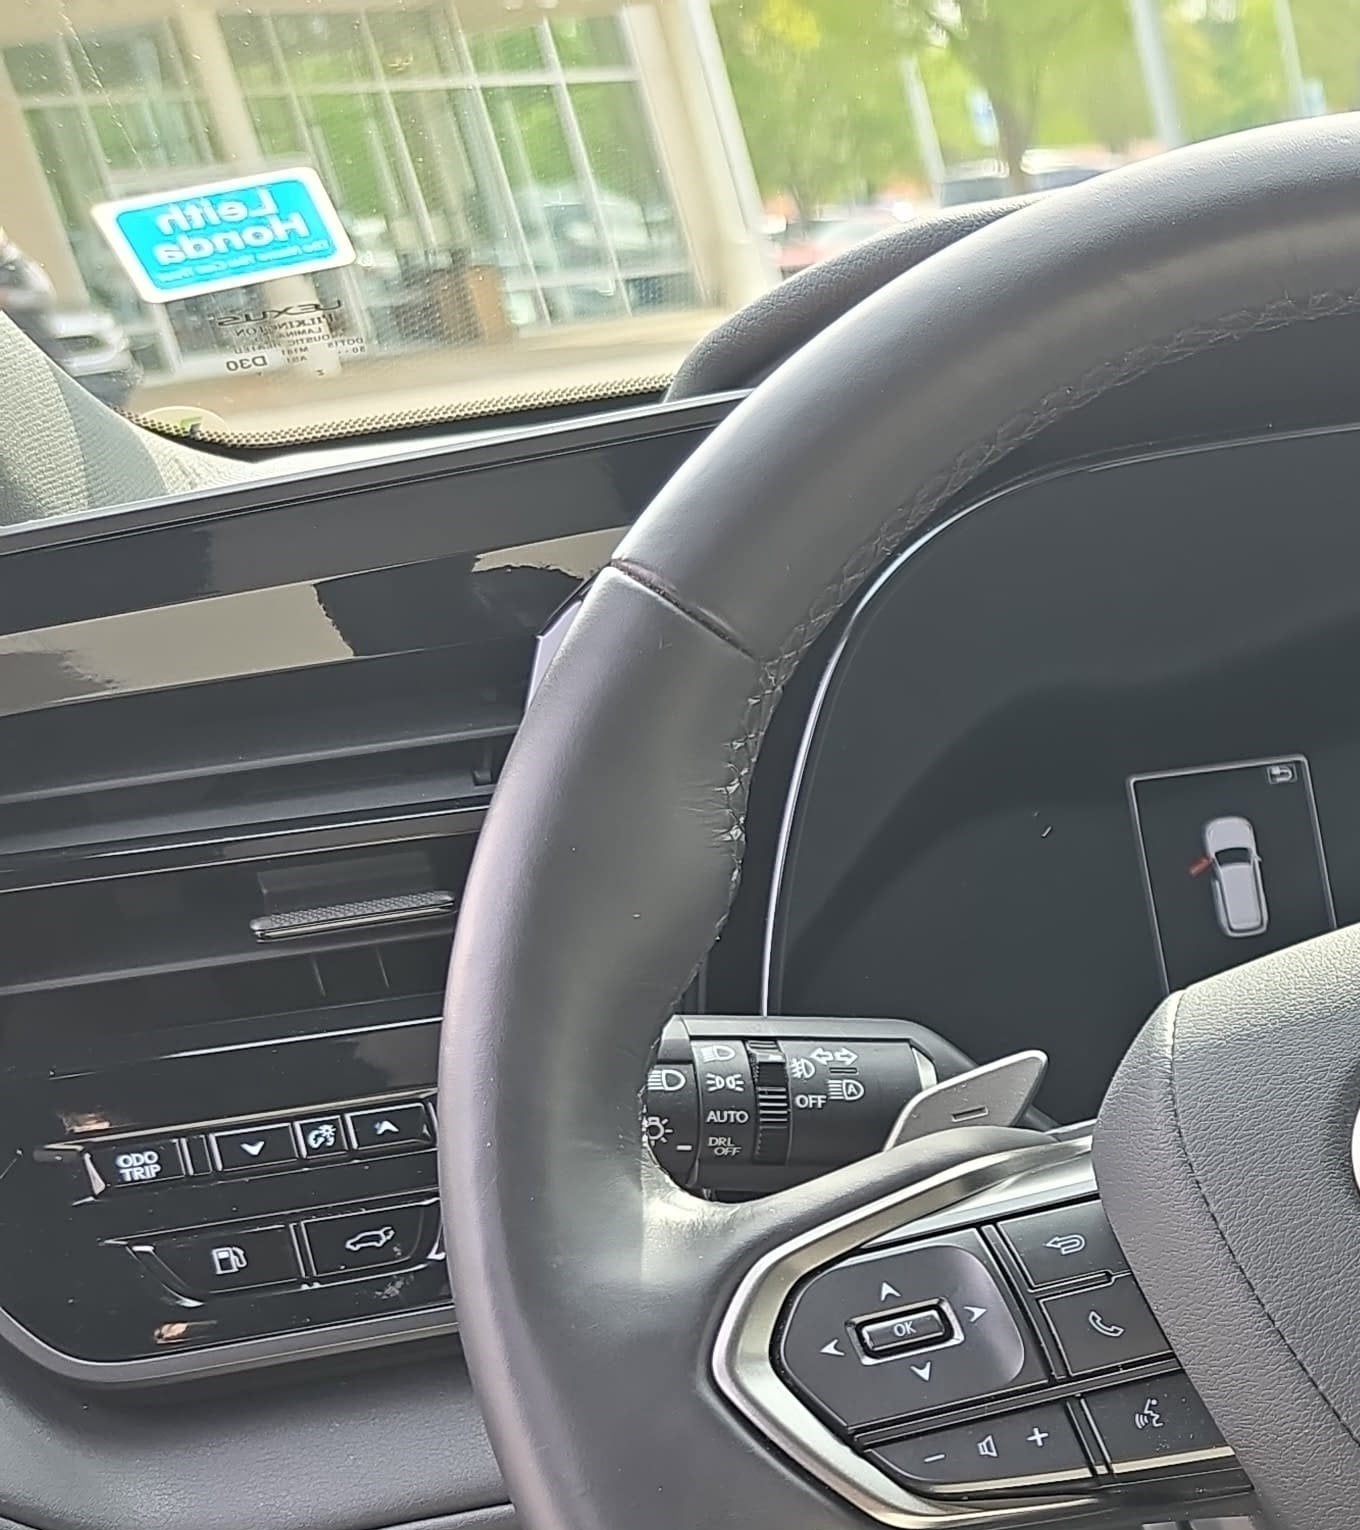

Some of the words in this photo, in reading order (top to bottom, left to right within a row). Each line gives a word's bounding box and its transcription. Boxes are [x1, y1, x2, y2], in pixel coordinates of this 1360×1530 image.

[795, 1094, 828, 1109] OFF
[706, 1110, 749, 1124] AUTO
[707, 1136, 735, 1147] DRL
[713, 1146, 742, 1156] OFF
[116, 1150, 159, 1168] ODO
[119, 1163, 161, 1182] TRIP
[893, 1320, 917, 1337] OK
